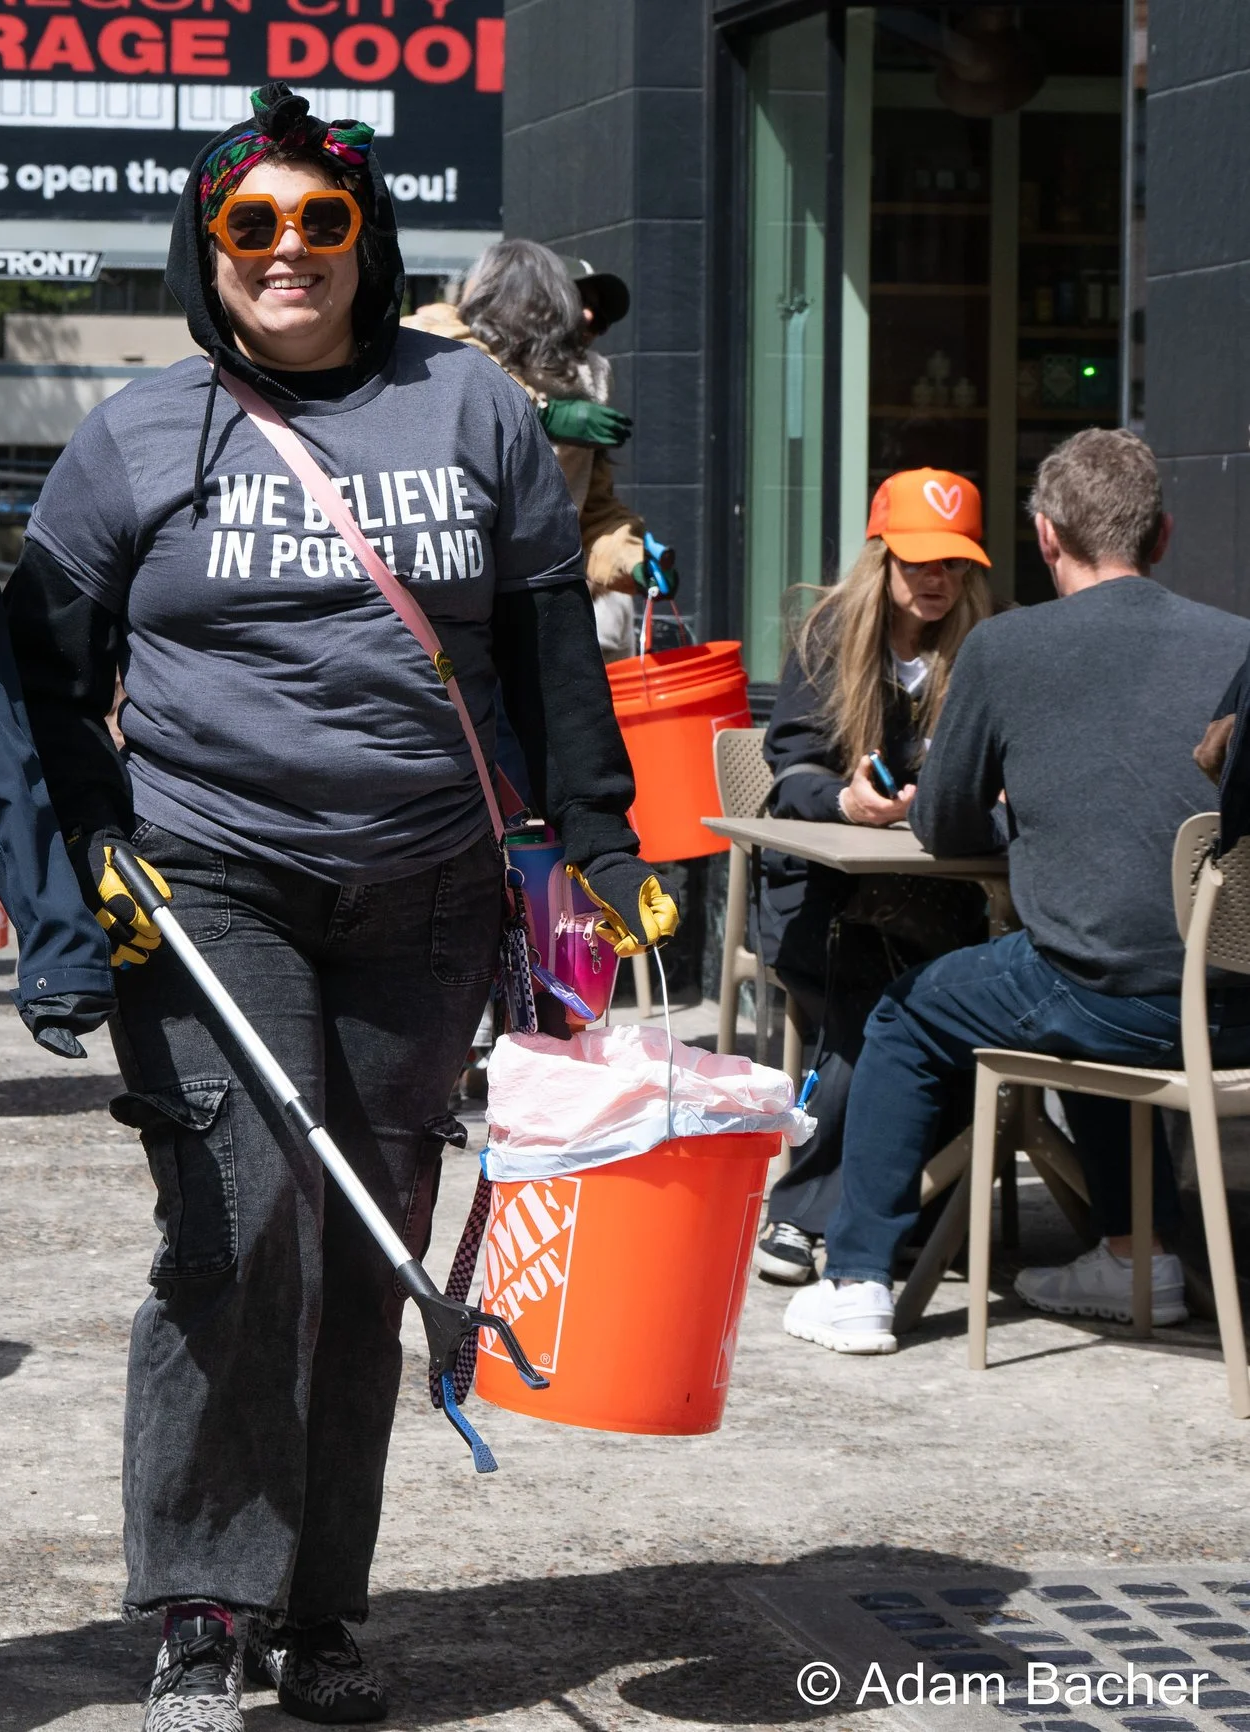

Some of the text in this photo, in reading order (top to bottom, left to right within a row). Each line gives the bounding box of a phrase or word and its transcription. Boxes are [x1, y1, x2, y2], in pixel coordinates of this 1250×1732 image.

[15, 164, 118, 199] open
[218, 474, 290, 526] WE
[207, 531, 255, 579] IN
[482, 1180, 574, 1302] OME
